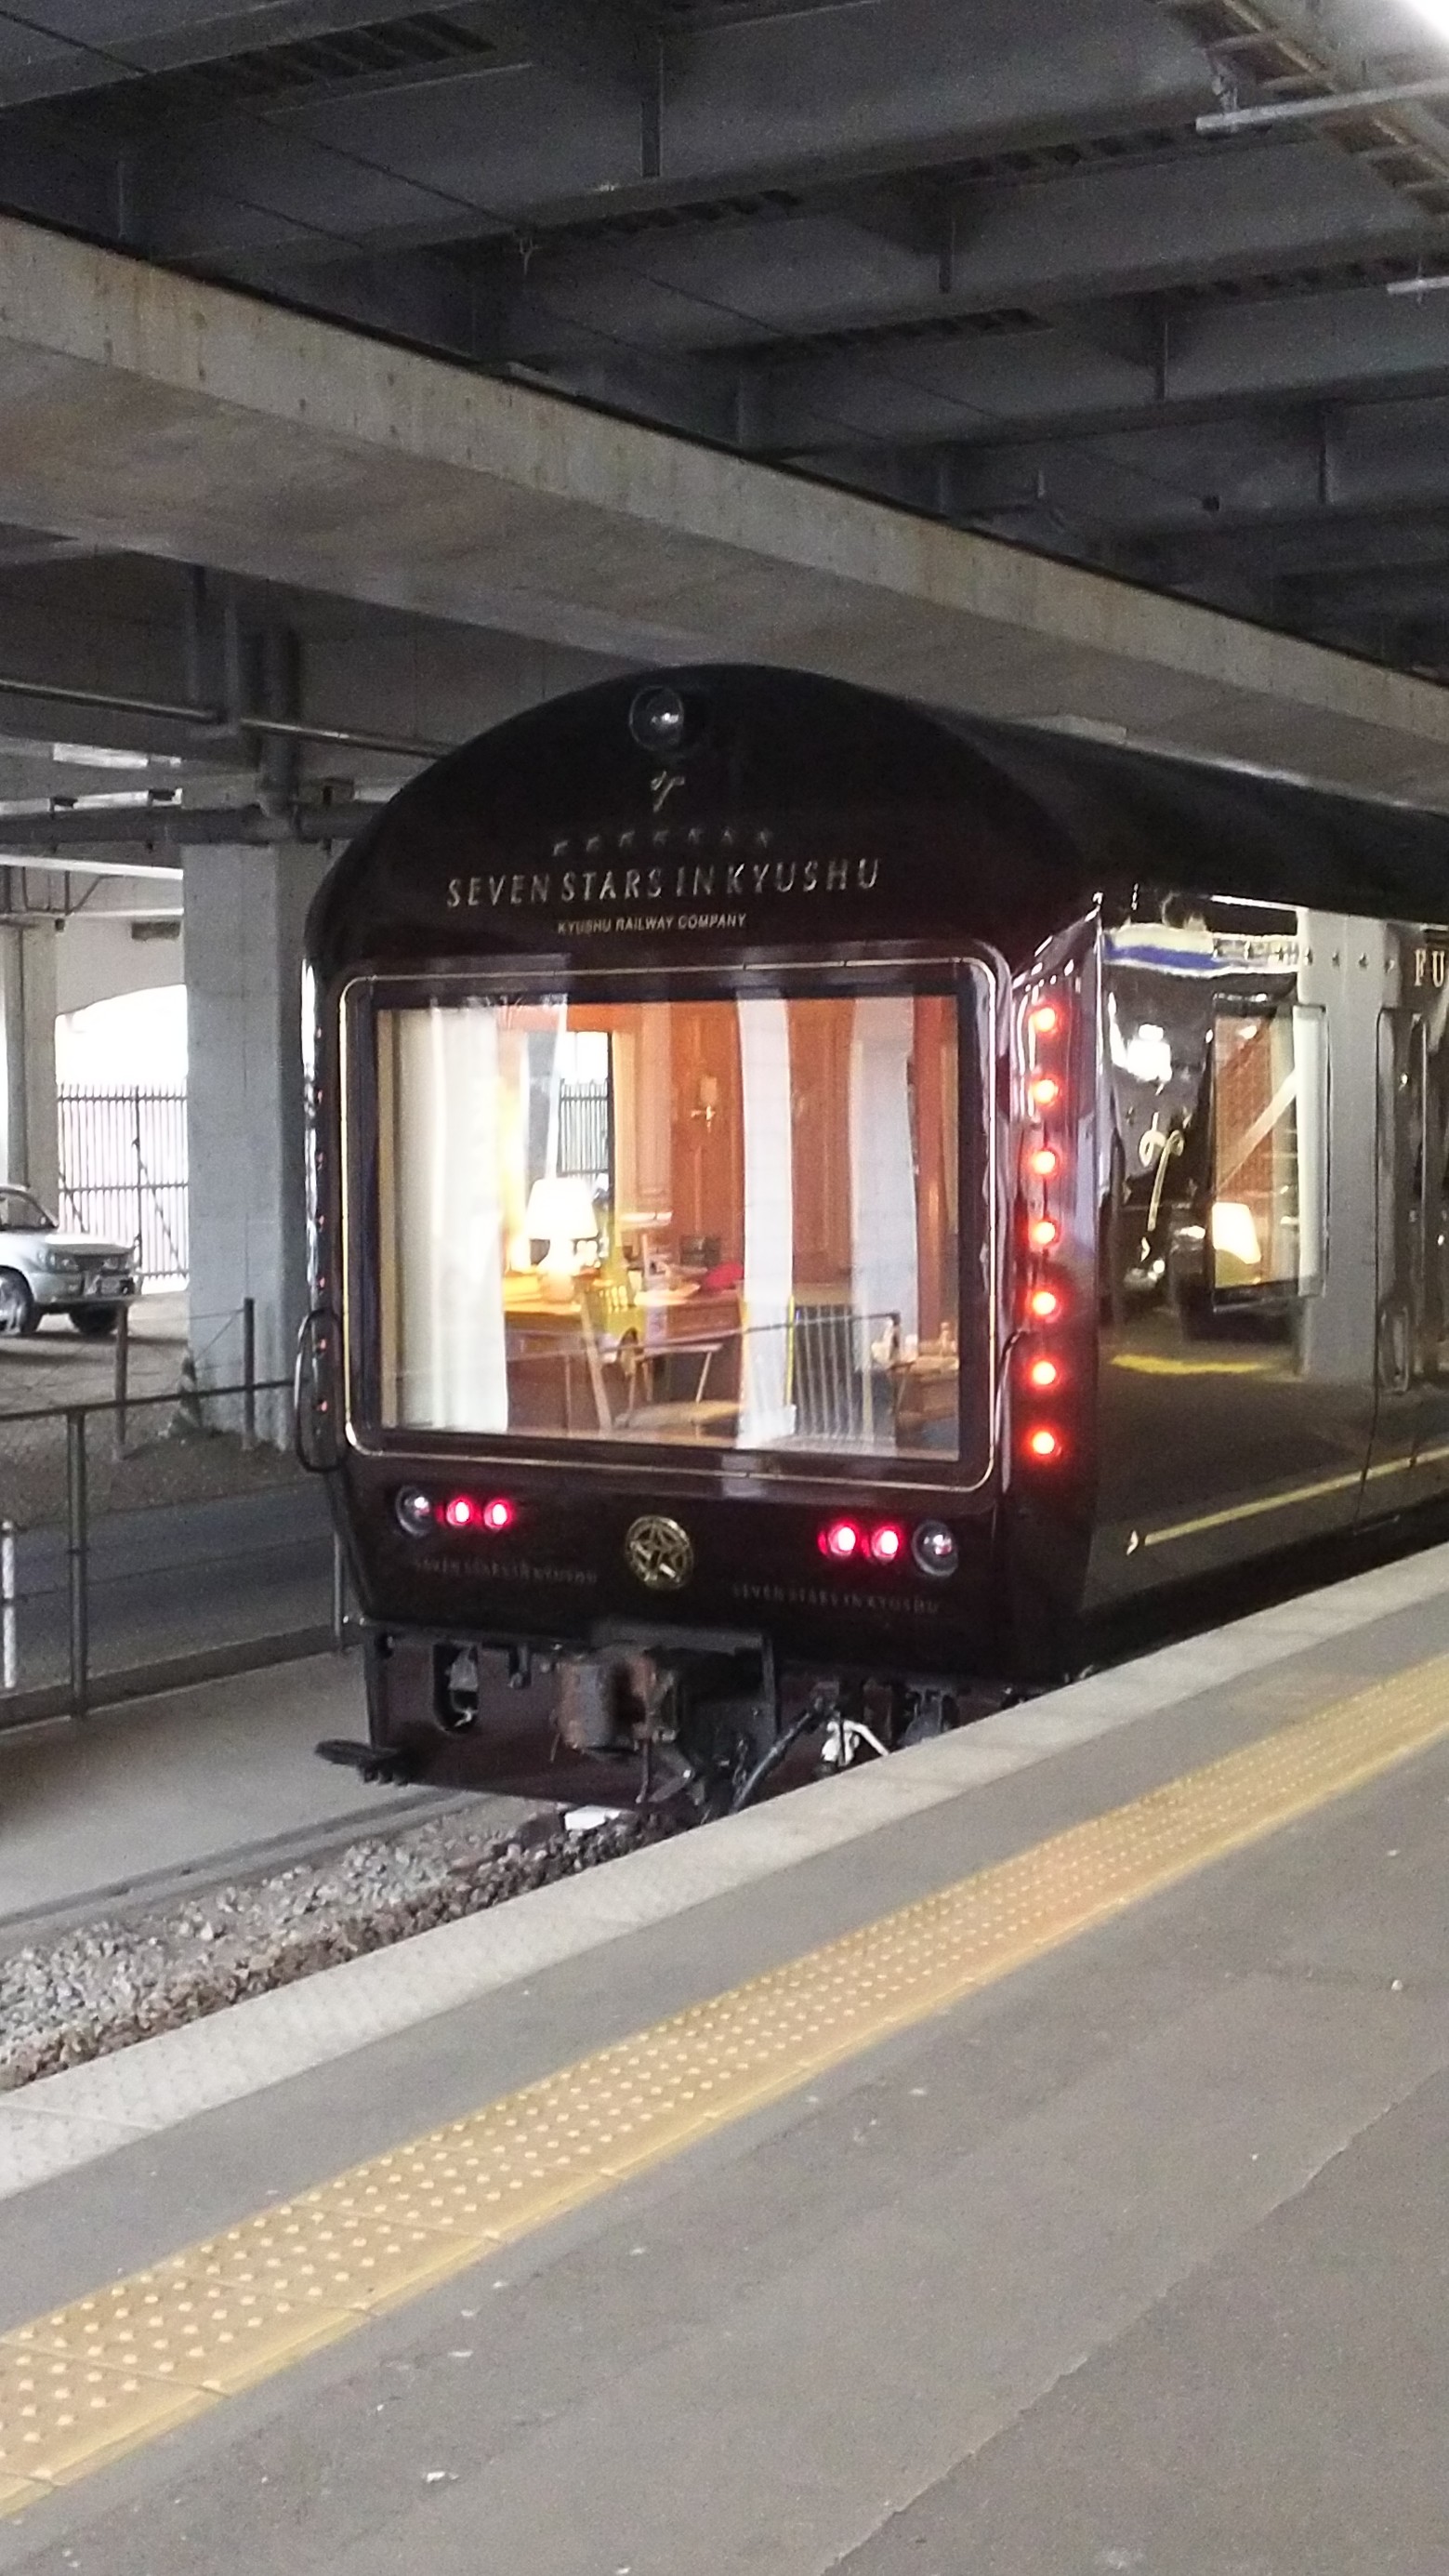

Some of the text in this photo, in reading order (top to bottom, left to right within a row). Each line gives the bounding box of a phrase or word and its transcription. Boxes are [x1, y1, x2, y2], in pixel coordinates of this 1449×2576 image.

[447, 858, 880, 907] SEVEN STARS IN KYUSHU
[558, 913, 746, 935] KYUSHU RAILWAY COMPANY
